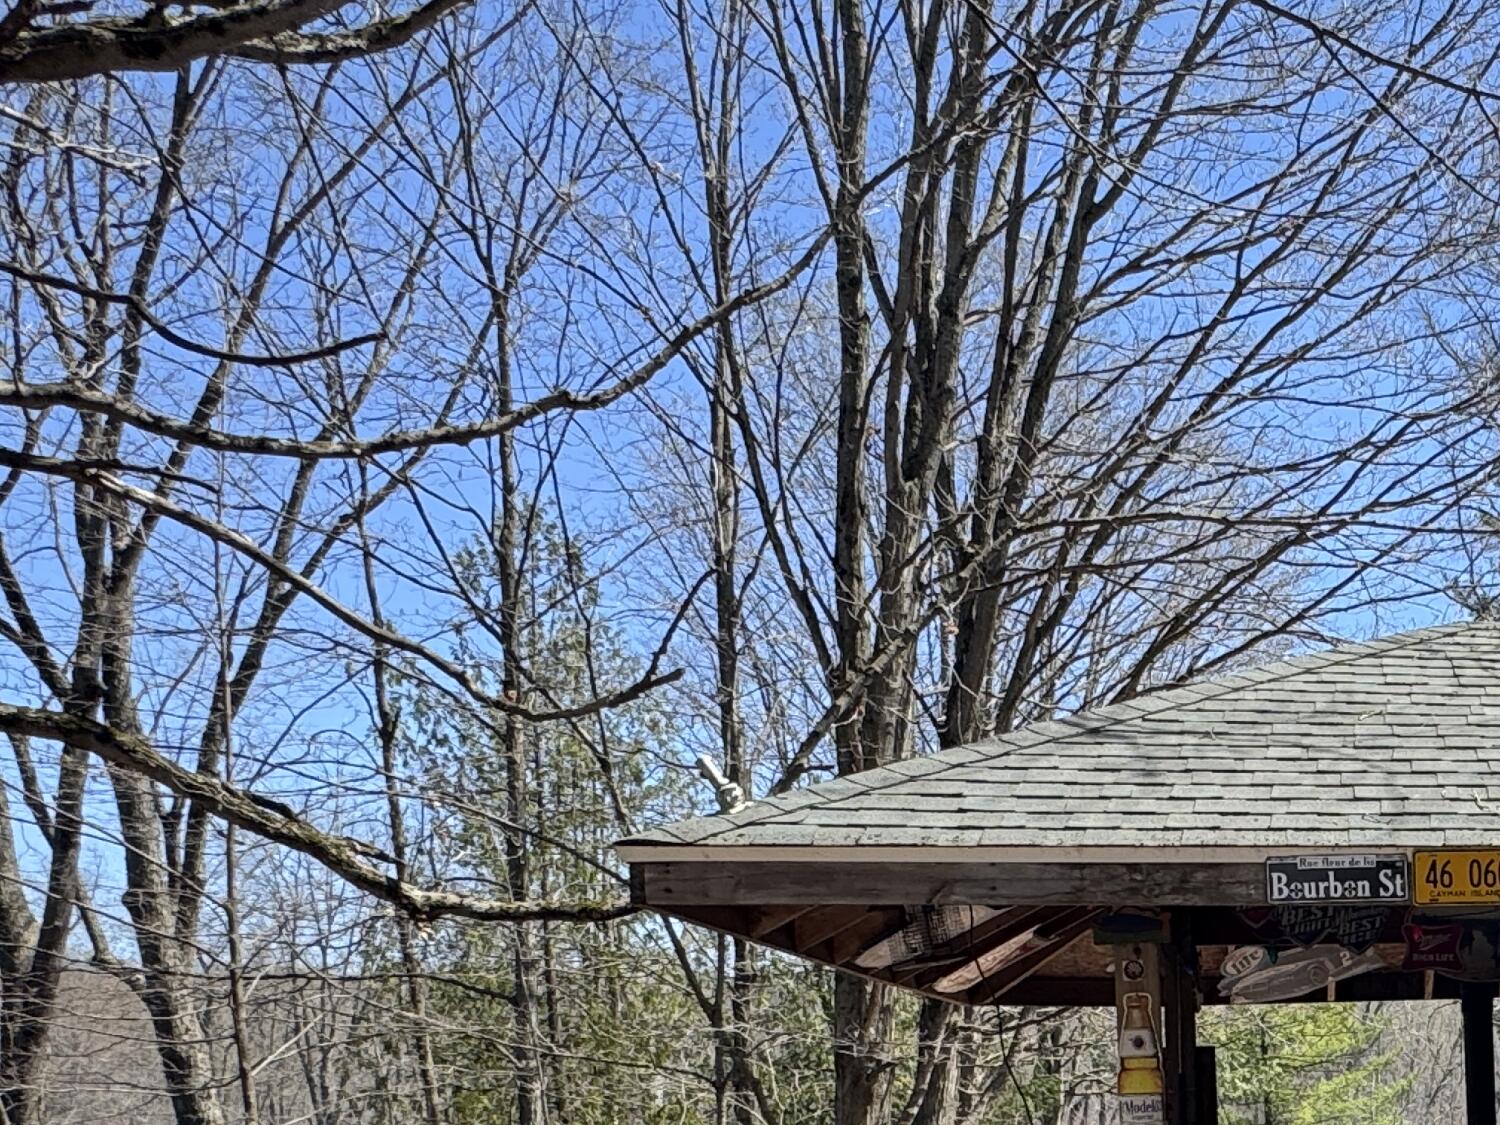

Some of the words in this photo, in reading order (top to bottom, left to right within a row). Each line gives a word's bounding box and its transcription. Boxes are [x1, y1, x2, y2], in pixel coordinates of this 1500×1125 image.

[1349, 856, 1361, 866] de
[1425, 858, 1454, 889] 46
[1270, 870, 1372, 900] Bourbon
[1378, 868, 1405, 898] St
[1429, 890, 1466, 898] CAYMAN
[1339, 916, 1382, 935] BEST
[1340, 950, 1353, 967] 2
